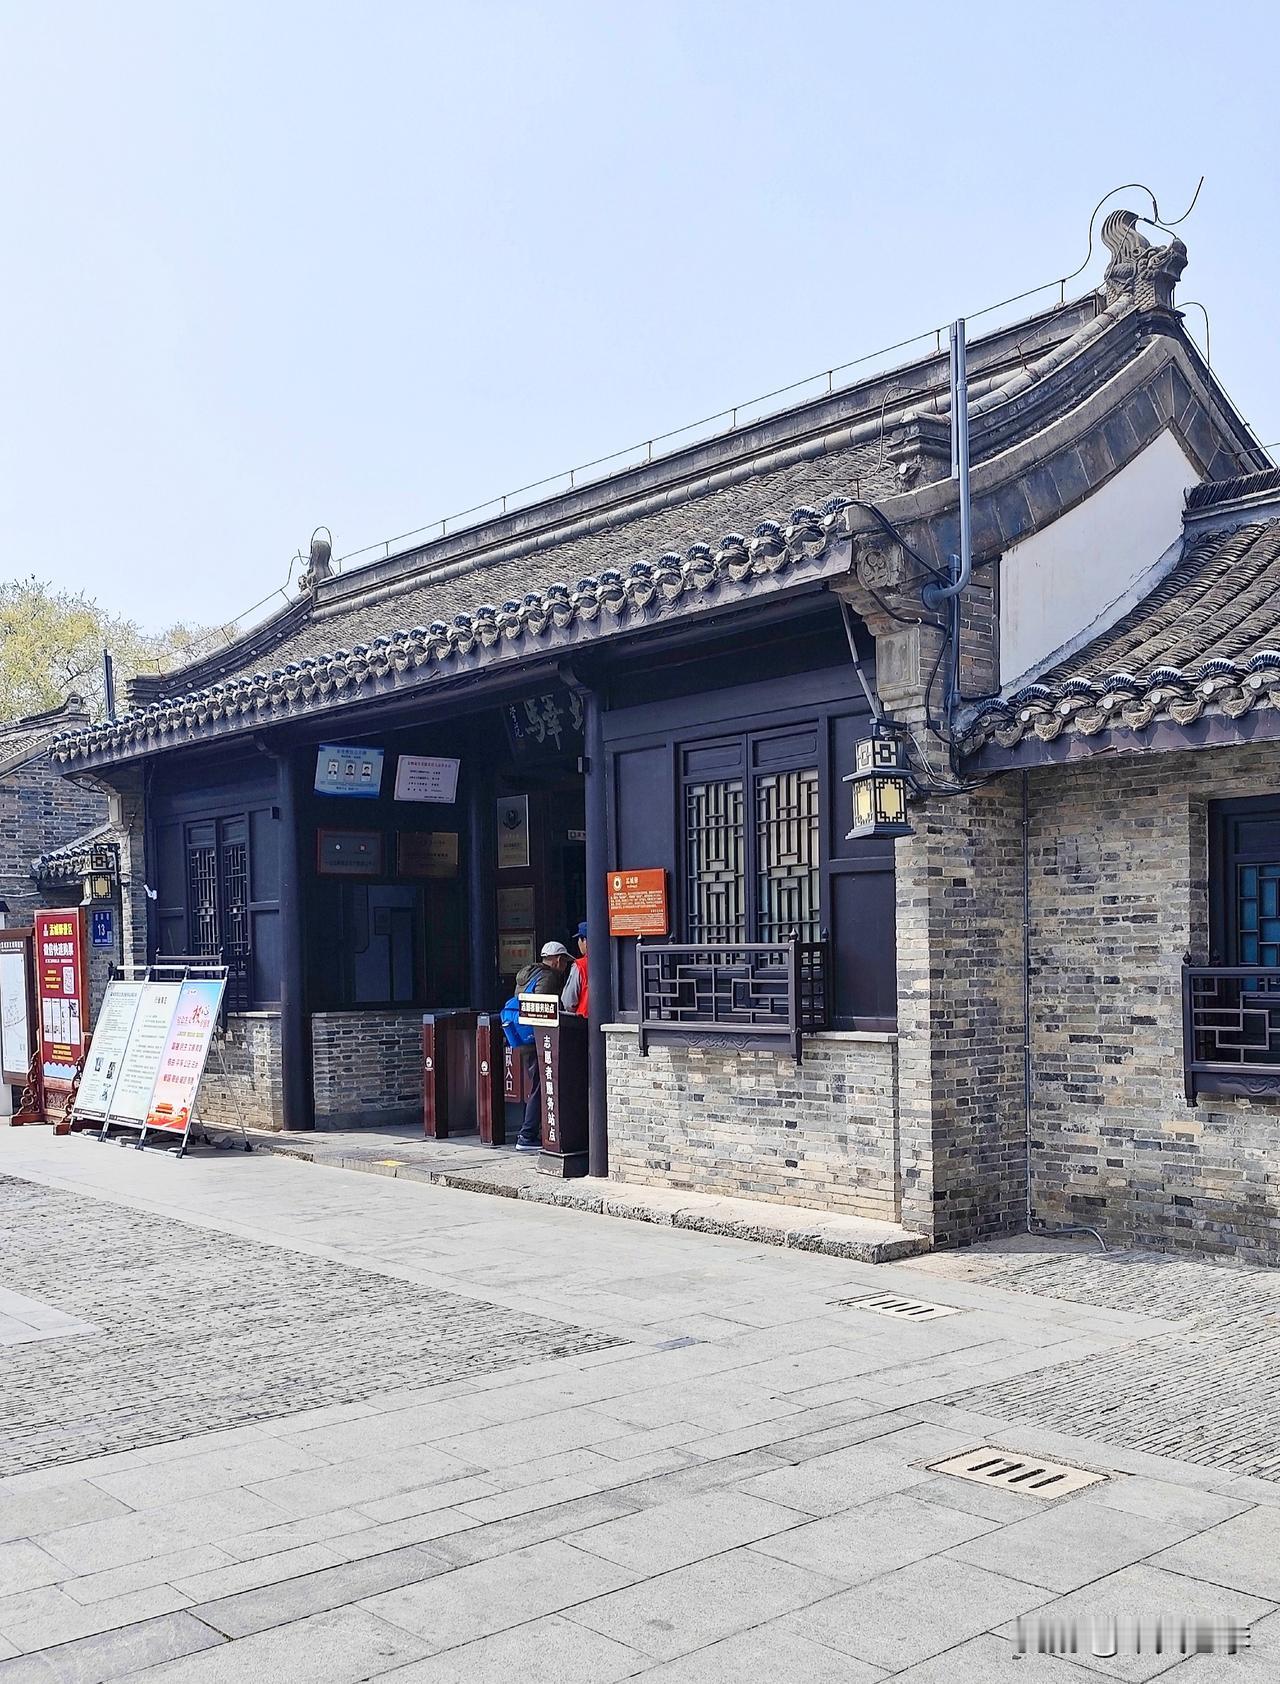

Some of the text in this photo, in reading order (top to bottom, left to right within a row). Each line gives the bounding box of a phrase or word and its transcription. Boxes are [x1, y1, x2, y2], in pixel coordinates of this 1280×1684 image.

[97, 923, 106, 936] 13
[520, 1002, 555, 1014] 志愿者服务站点
[543, 1035, 556, 1142] 志愿者服务站点
